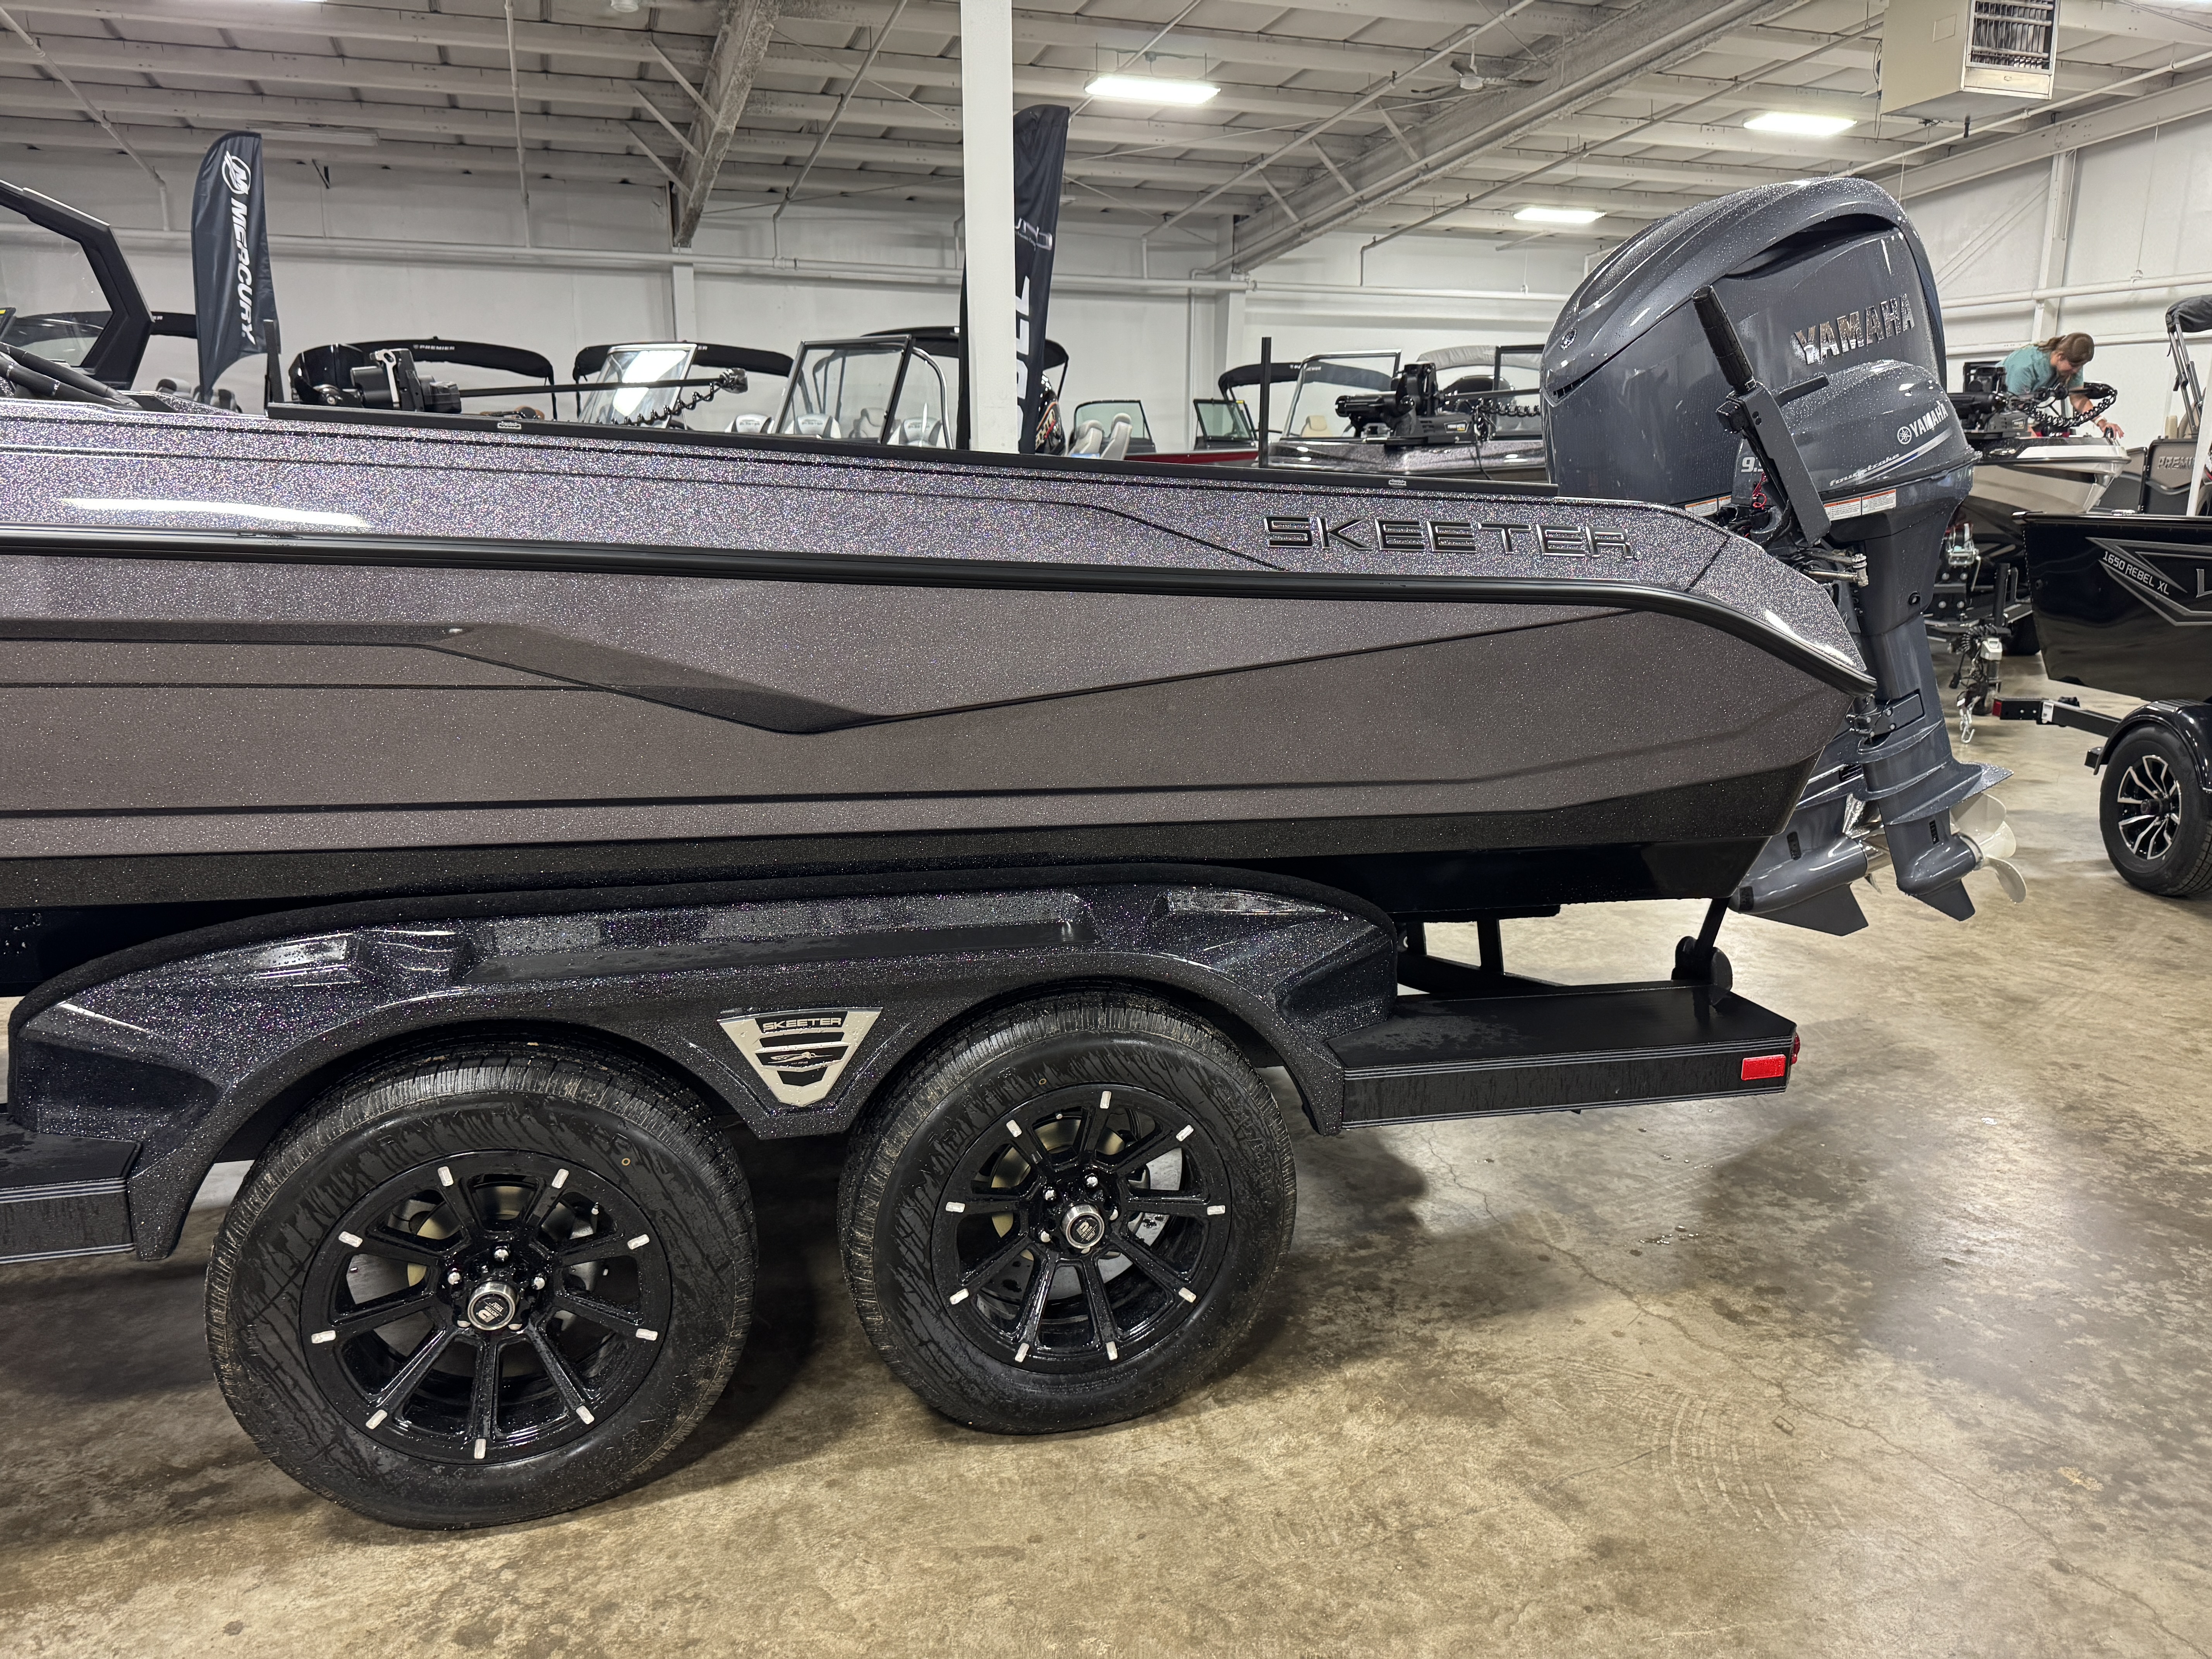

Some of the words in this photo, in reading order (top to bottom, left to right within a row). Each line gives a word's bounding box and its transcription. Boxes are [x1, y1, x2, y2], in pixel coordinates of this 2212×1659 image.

[231, 198, 256, 345] MERCURY
[1794, 293, 1915, 364] YAMAHA
[1909, 402, 1949, 437] YAMAHA
[1263, 515, 1638, 560] SKEETER
[2102, 551, 2125, 570] 1650
[2125, 564, 2154, 587] REBEL
[2157, 580, 2169, 595] XL
[763, 1017, 842, 1031] SKEETER
[484, 1305, 499, 1317] DEXTER
